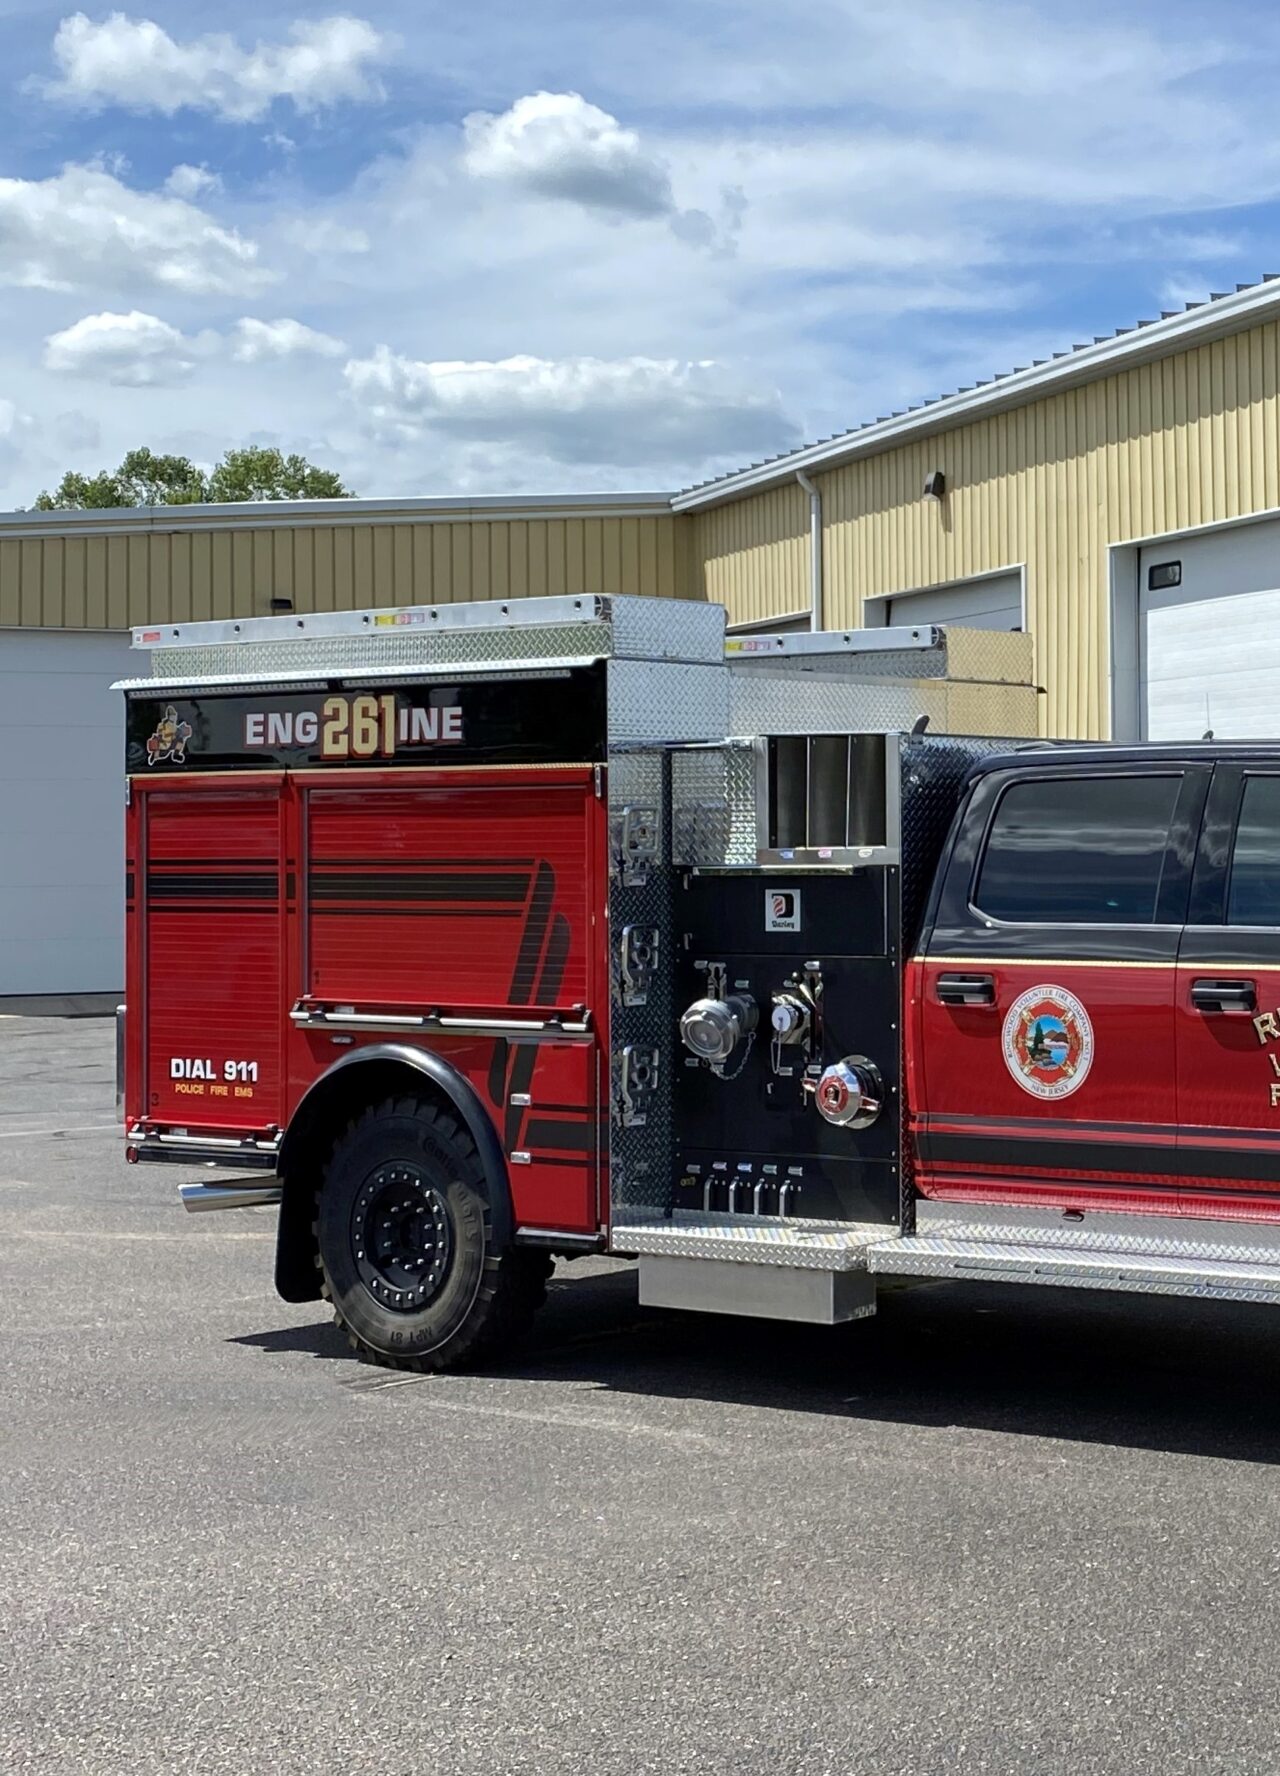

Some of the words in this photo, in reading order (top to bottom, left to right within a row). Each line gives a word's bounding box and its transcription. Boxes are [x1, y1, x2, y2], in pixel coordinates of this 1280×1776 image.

[320, 694, 397, 759] 261
[171, 1058, 217, 1080] DIAL
[223, 1060, 258, 1082] 911
[175, 1083, 204, 1095] POLICE
[210, 1085, 228, 1096] FIRE
[234, 1086, 253, 1098] EMS
